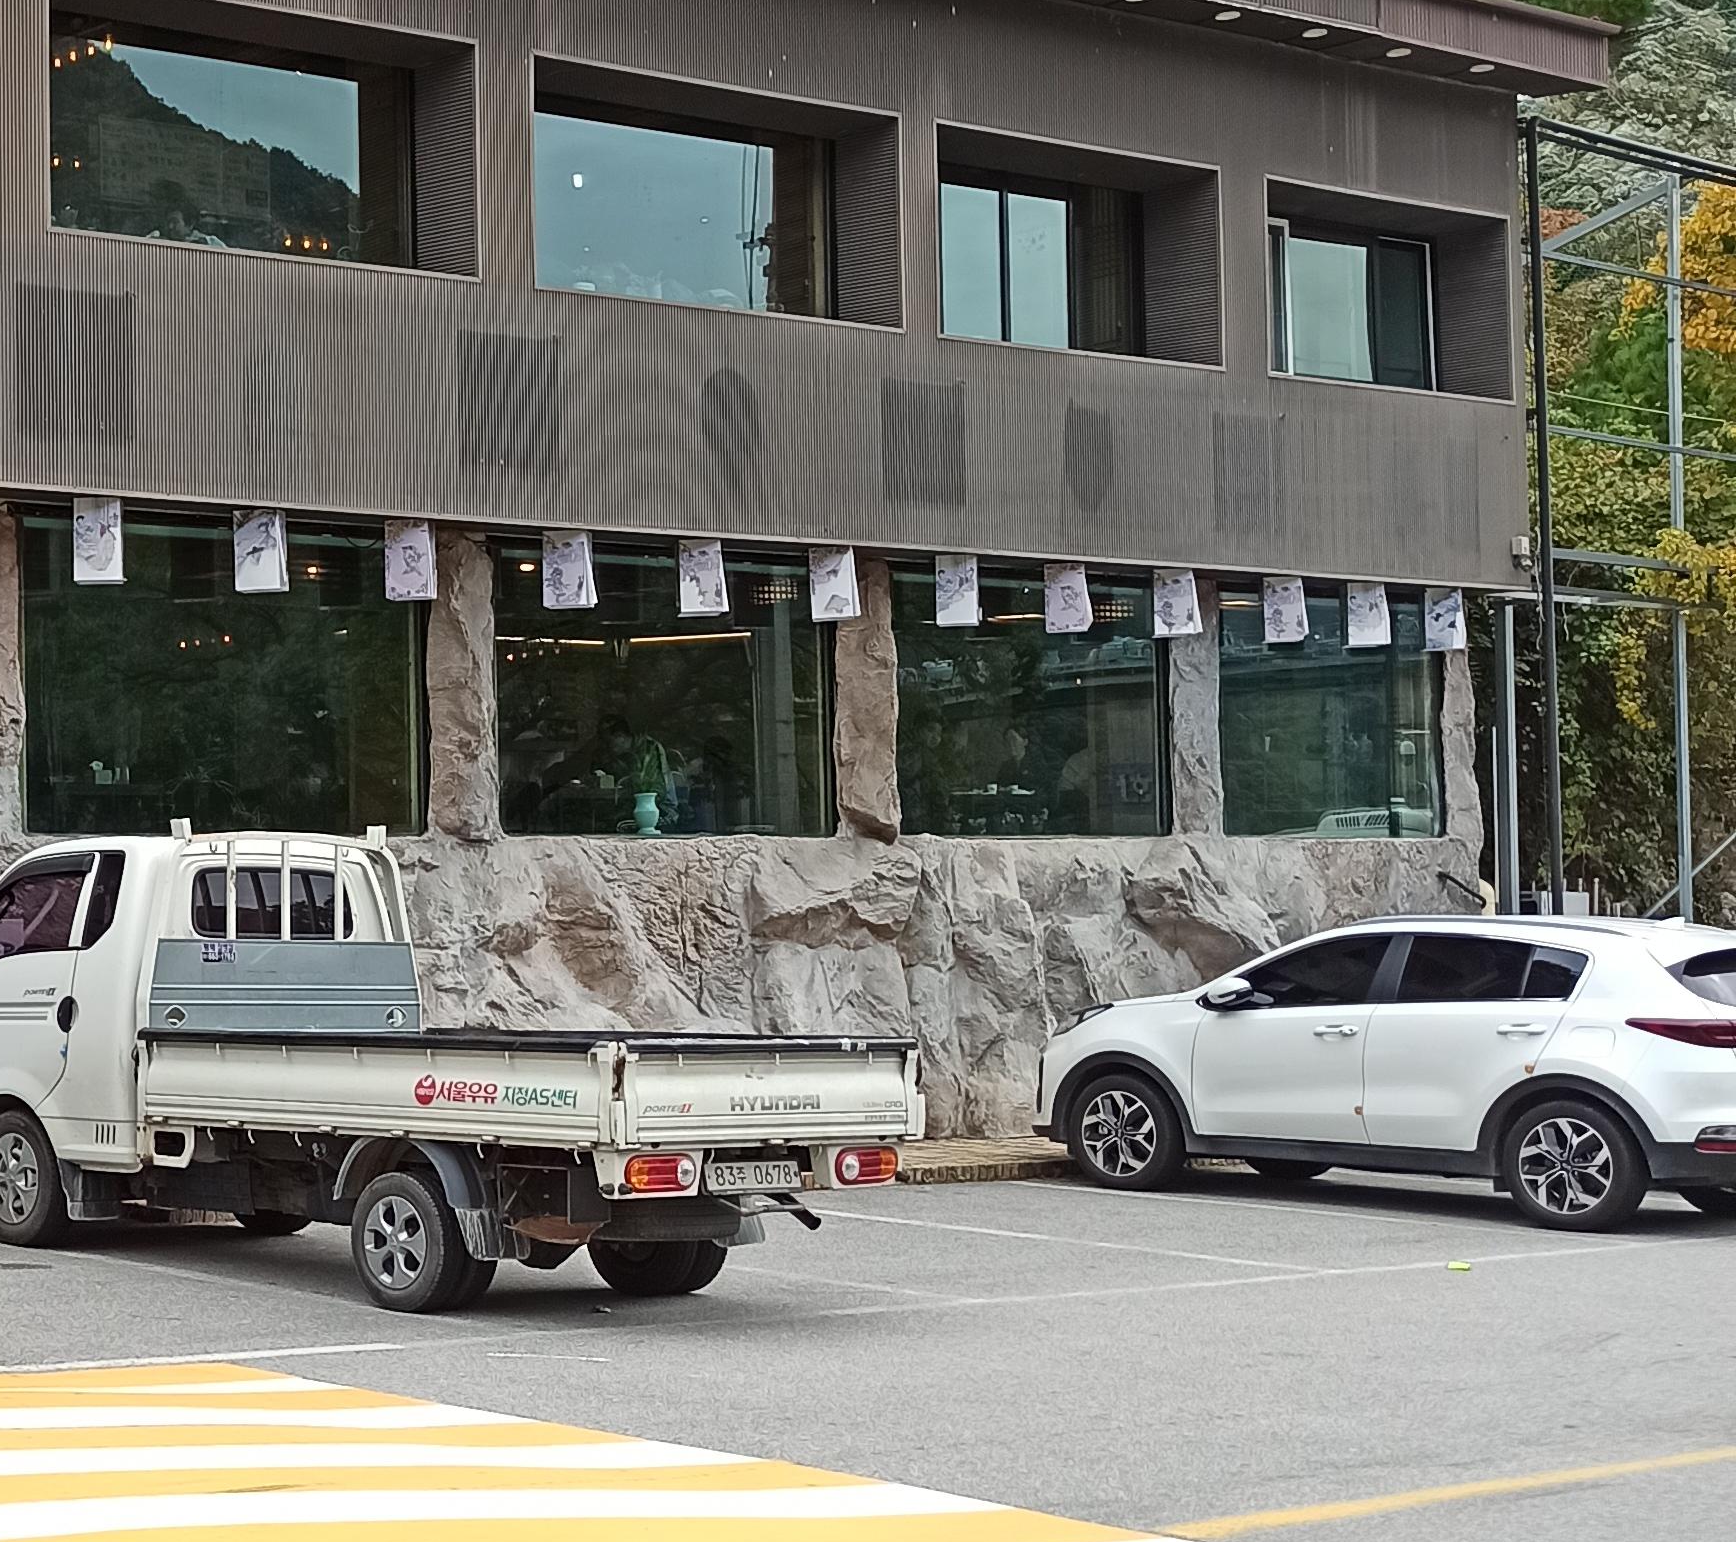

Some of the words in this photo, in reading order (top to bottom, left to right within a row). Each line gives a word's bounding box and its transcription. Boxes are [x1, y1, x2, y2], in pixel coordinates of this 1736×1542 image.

[436, 1081, 498, 1105] 서울우유
[502, 1085, 578, 1109] 지정AS센터
[729, 1094, 821, 1112] HYUNDAI
[753, 1164, 793, 1186] 0678
